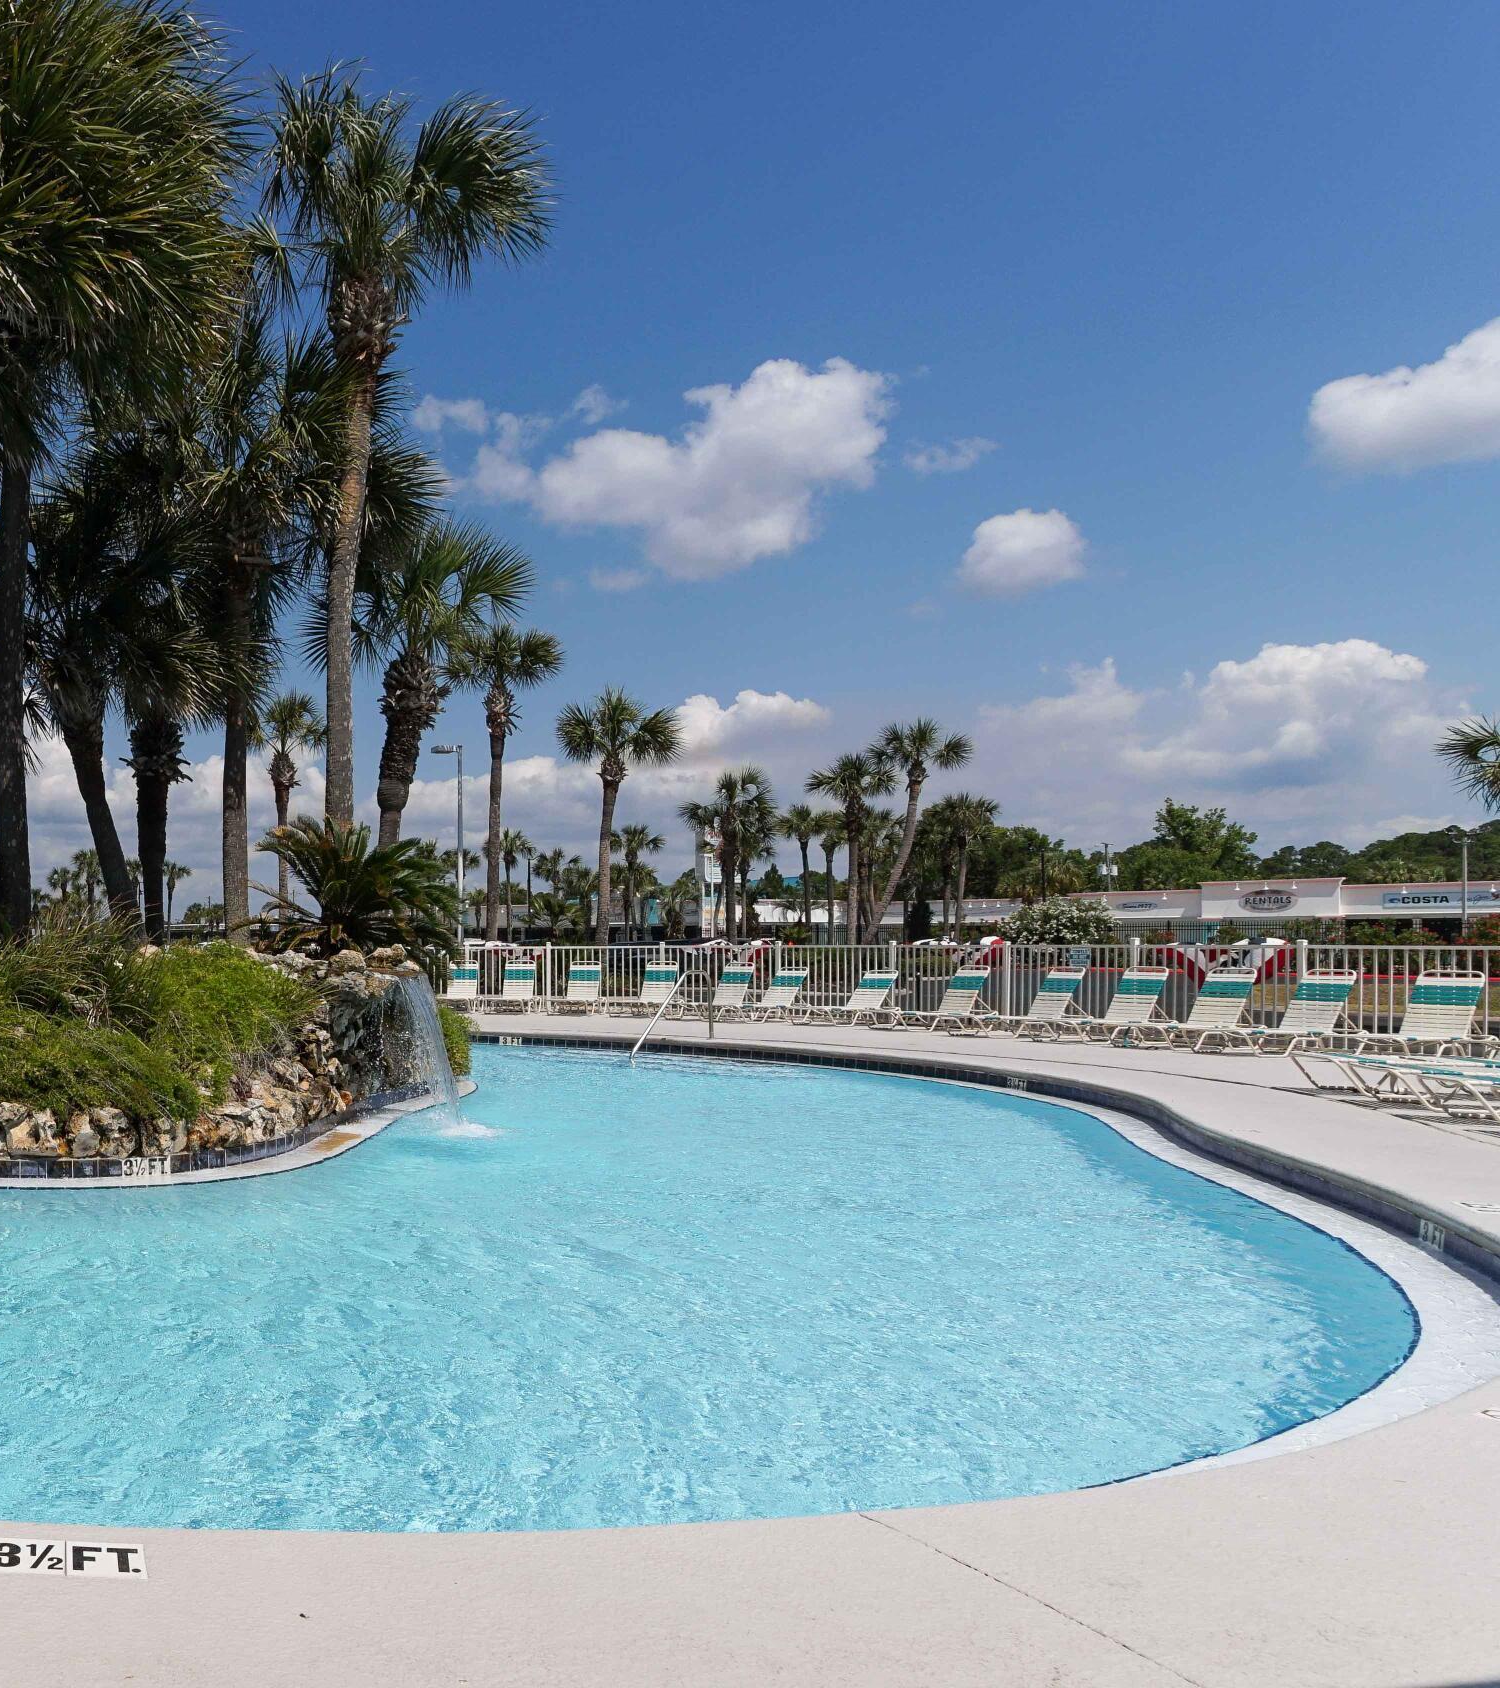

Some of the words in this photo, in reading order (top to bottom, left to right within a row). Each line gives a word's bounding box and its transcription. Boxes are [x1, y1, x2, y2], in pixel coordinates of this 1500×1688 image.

[1244, 896, 1292, 905] RENTALS
[1402, 896, 1449, 904] COSTA
[502, 1036, 508, 1045] 3
[511, 1037, 520, 1045] FT
[123, 1159, 146, 1176] 3½
[72, 1545, 142, 1573] FT.
